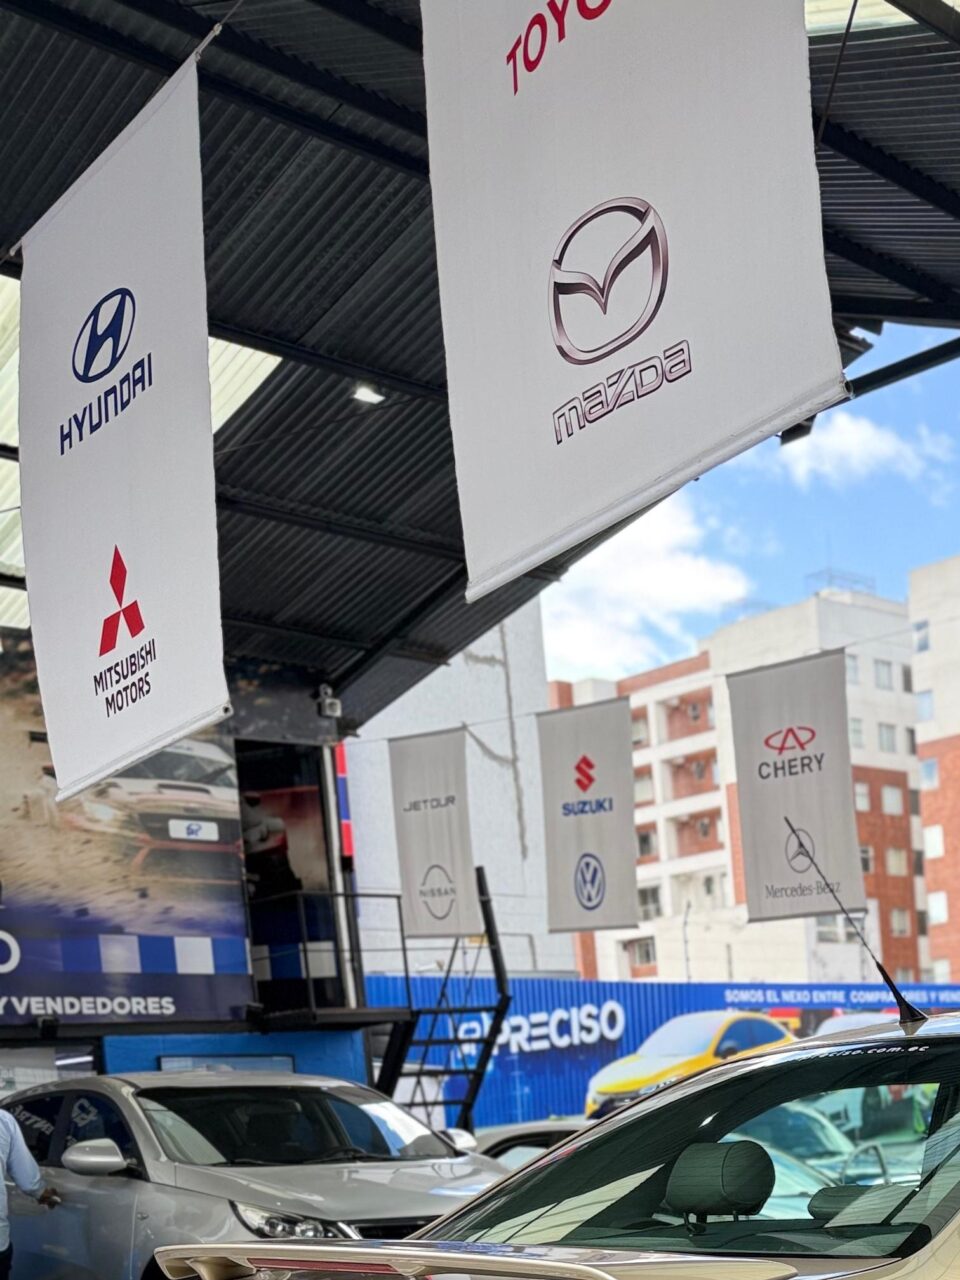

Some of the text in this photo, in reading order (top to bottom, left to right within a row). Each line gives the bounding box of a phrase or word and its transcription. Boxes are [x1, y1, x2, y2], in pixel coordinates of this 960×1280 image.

[59, 351, 153, 456] HYUNDAI
[93, 638, 157, 696] MITSUBISHI
[105, 671, 151, 718] MOTORS
[758, 752, 826, 780] CHERY
[403, 795, 456, 812] JETOUR
[562, 797, 614, 817] SUZUKI
[418, 887, 457, 898] NISSAN
[11, 996, 176, 1015] VENDEDORES
[724, 989, 764, 1003] SOMOS
[766, 989, 780, 1003] EL
[781, 989, 811, 1003] NEXO
[812, 989, 845, 1003] ENTRE
